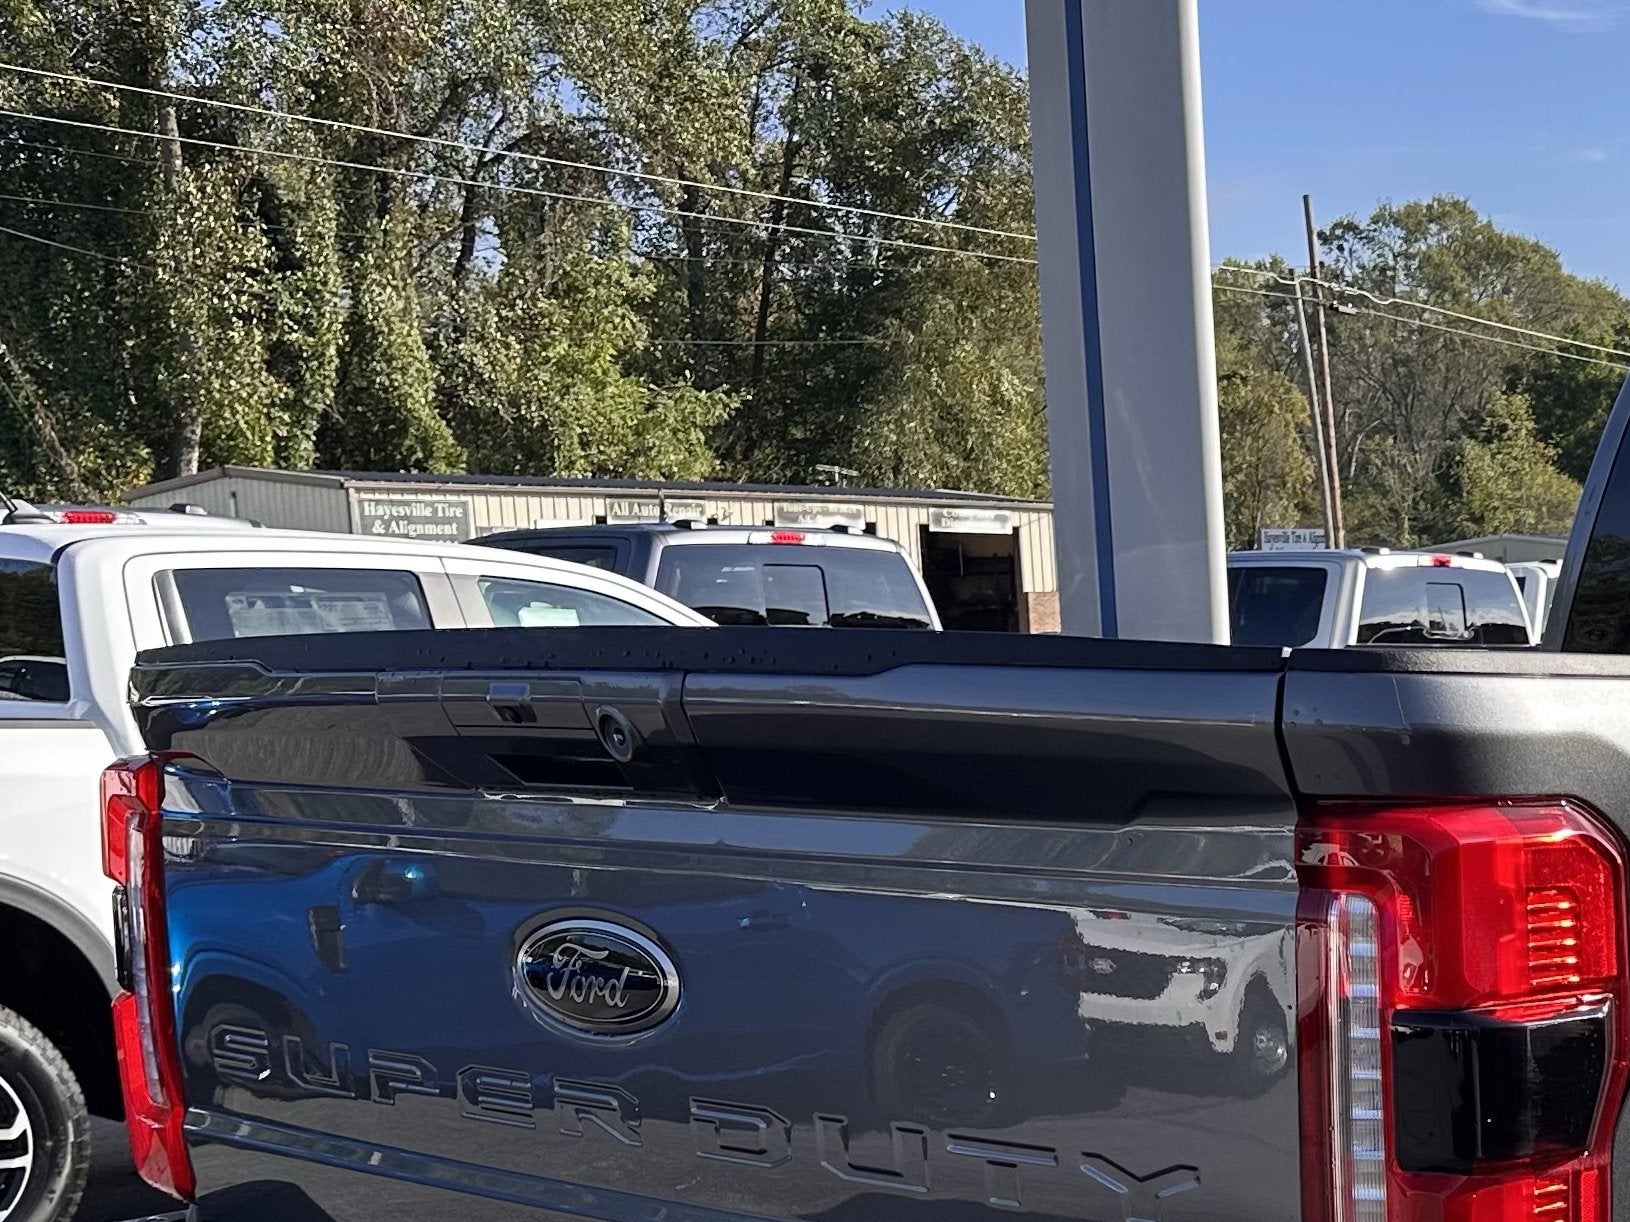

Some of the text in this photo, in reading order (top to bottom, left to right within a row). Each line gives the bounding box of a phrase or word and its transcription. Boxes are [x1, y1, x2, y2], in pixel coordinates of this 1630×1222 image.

[363, 501, 463, 519] Hayesville Tire
[611, 501, 630, 516] All
[371, 520, 458, 537] & Alignment
[547, 942, 630, 1008] Ford
[208, 1023, 644, 1147] SUPER
